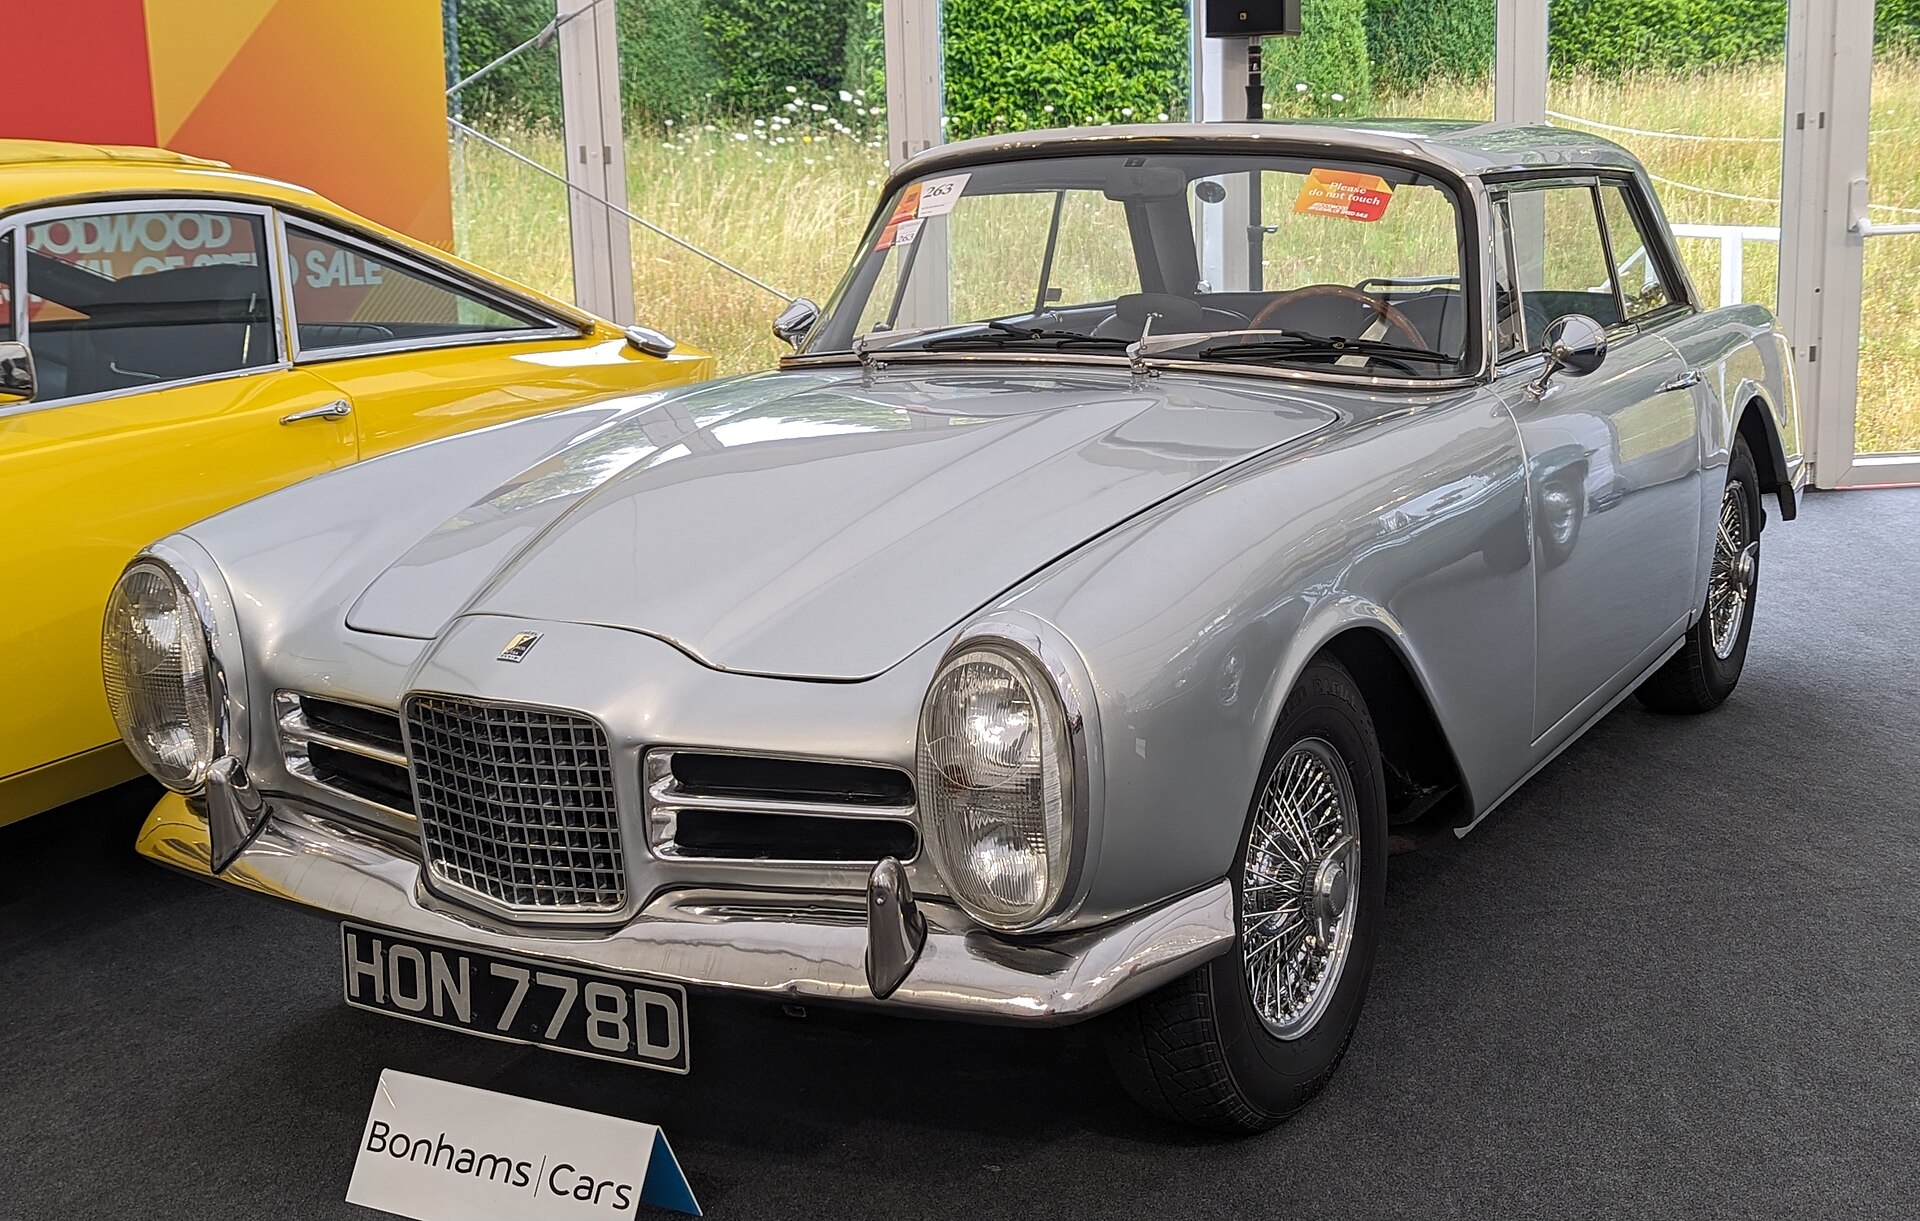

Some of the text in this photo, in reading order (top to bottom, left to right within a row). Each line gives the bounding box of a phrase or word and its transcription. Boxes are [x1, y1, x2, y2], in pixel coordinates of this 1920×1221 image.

[923, 183, 954, 199] 263
[1308, 188, 1381, 206] do not touch
[1329, 182, 1367, 195] Please
[306, 249, 383, 288] SALE
[346, 933, 681, 1061] HON 778D
[365, 1120, 633, 1210] Bonhams Cars
